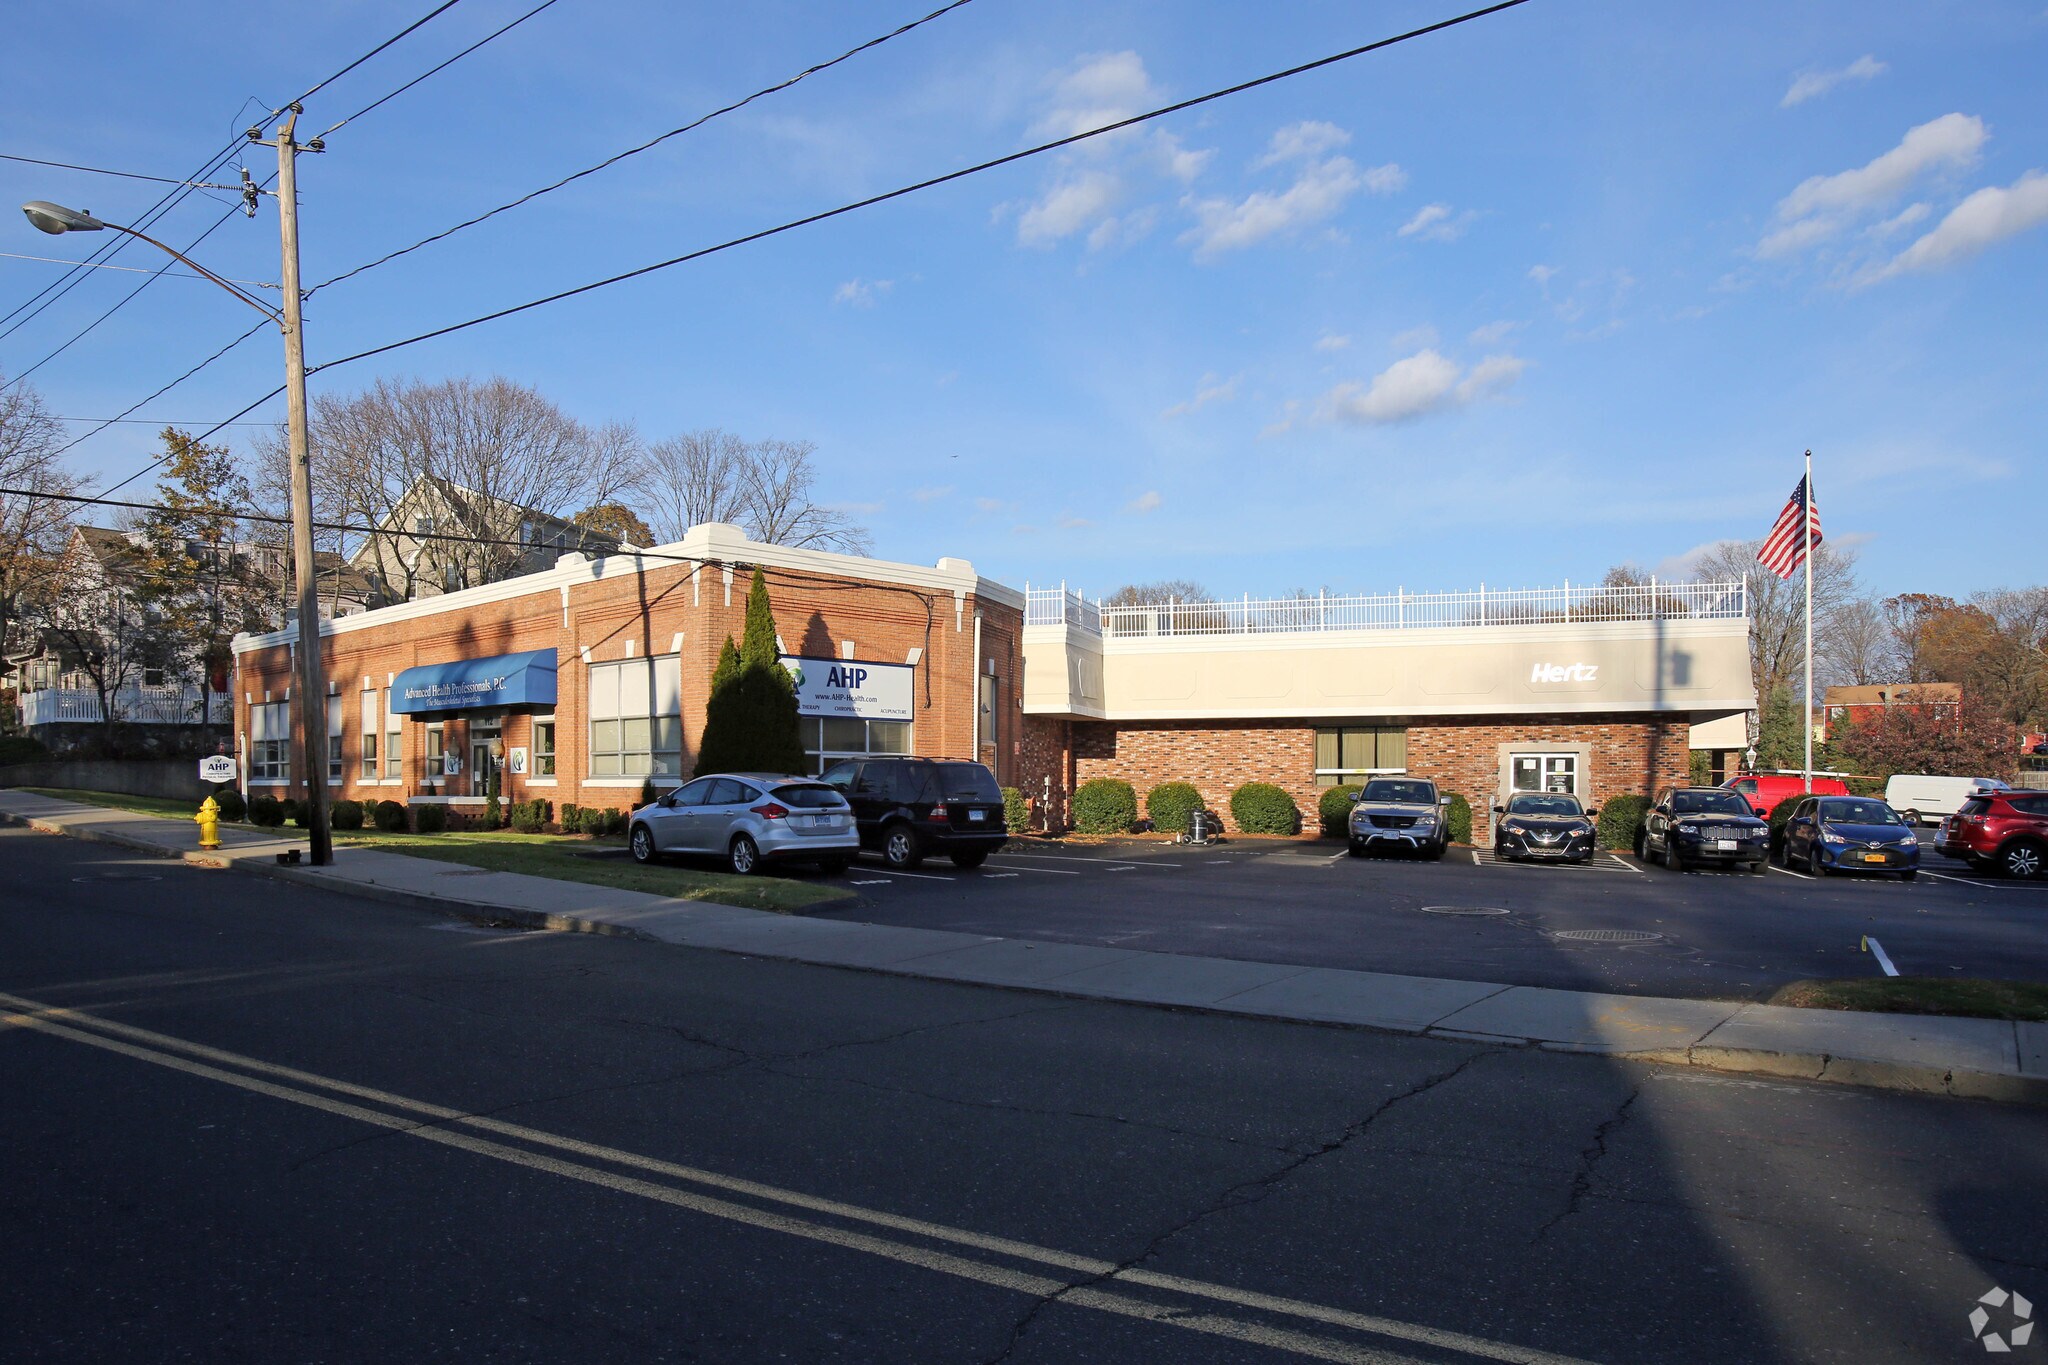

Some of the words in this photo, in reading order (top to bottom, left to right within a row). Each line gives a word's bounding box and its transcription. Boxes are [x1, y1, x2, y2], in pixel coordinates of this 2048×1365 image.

[826, 666, 868, 689] AHP
[1530, 662, 1600, 683] Hertz
[404, 685, 432, 700] Advanced
[432, 683, 451, 697] Health
[493, 677, 507, 691] P.C.
[815, 693, 878, 703] www.AHP-Health.com
[208, 763, 229, 771] AHP
